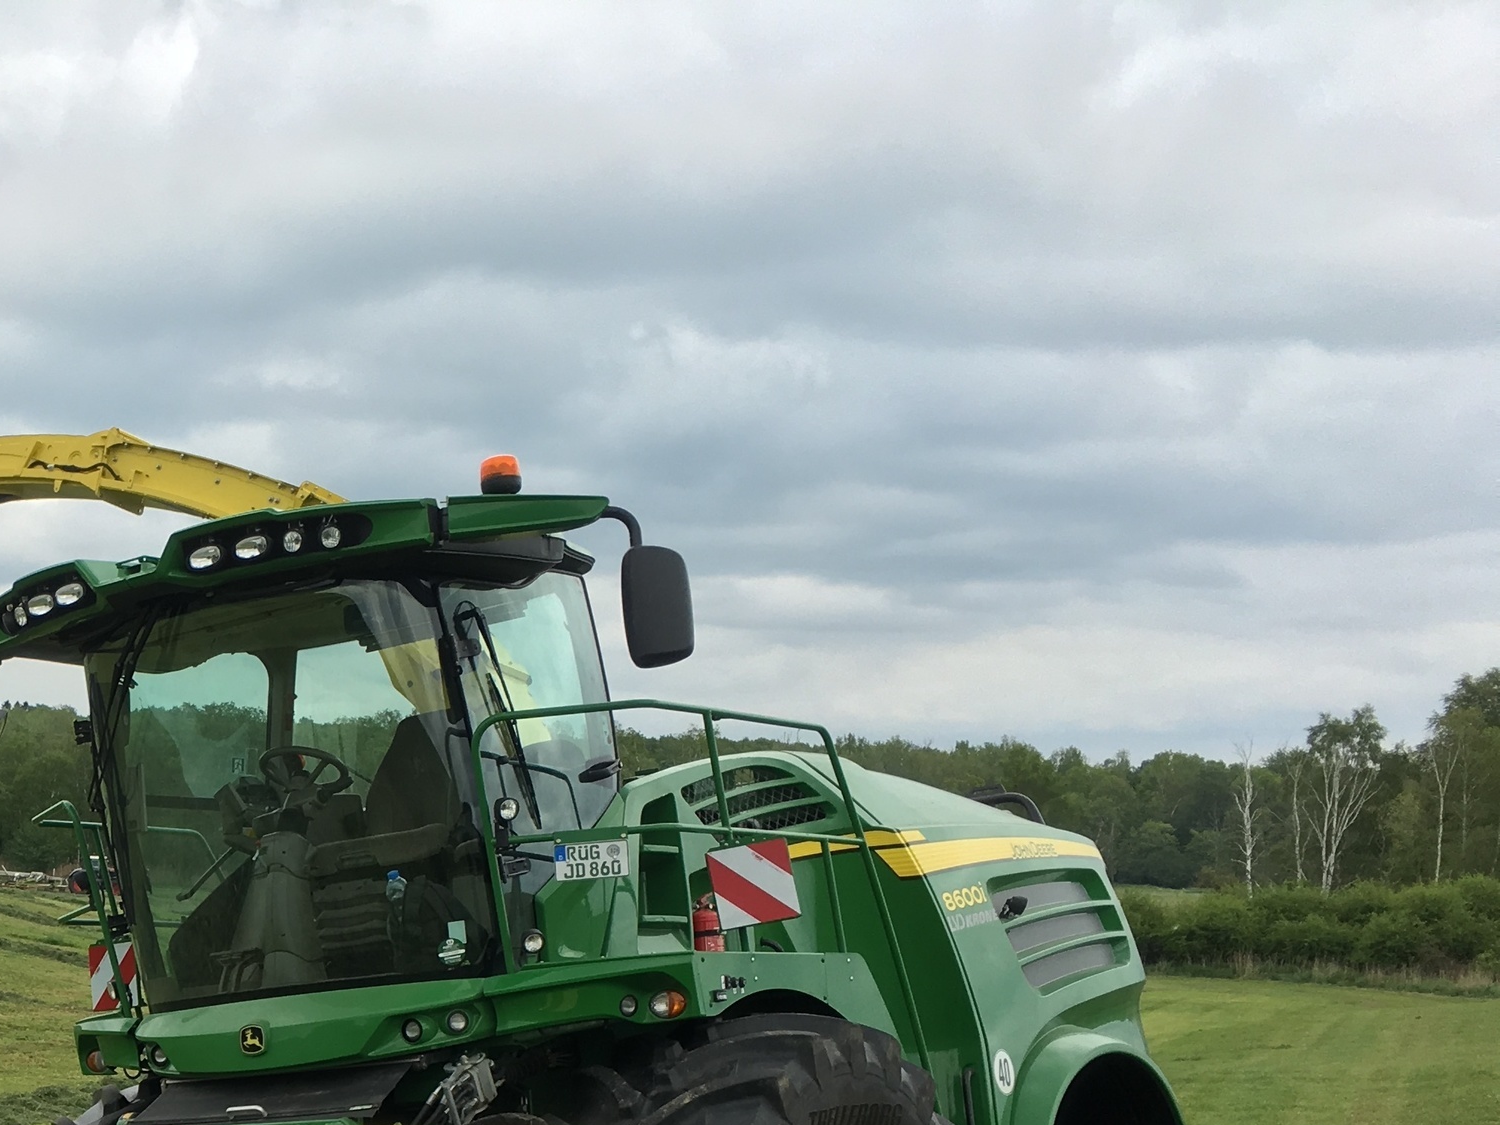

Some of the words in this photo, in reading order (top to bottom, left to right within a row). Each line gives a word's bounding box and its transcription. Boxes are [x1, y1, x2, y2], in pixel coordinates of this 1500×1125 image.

[566, 845, 601, 862] RÜG
[1029, 841, 1058, 858] DEERE
[564, 862, 586, 879] JD
[589, 860, 622, 877] 860
[942, 881, 987, 911] 8600i
[965, 908, 1000, 928] KRONE
[999, 1058, 1011, 1087] 40
